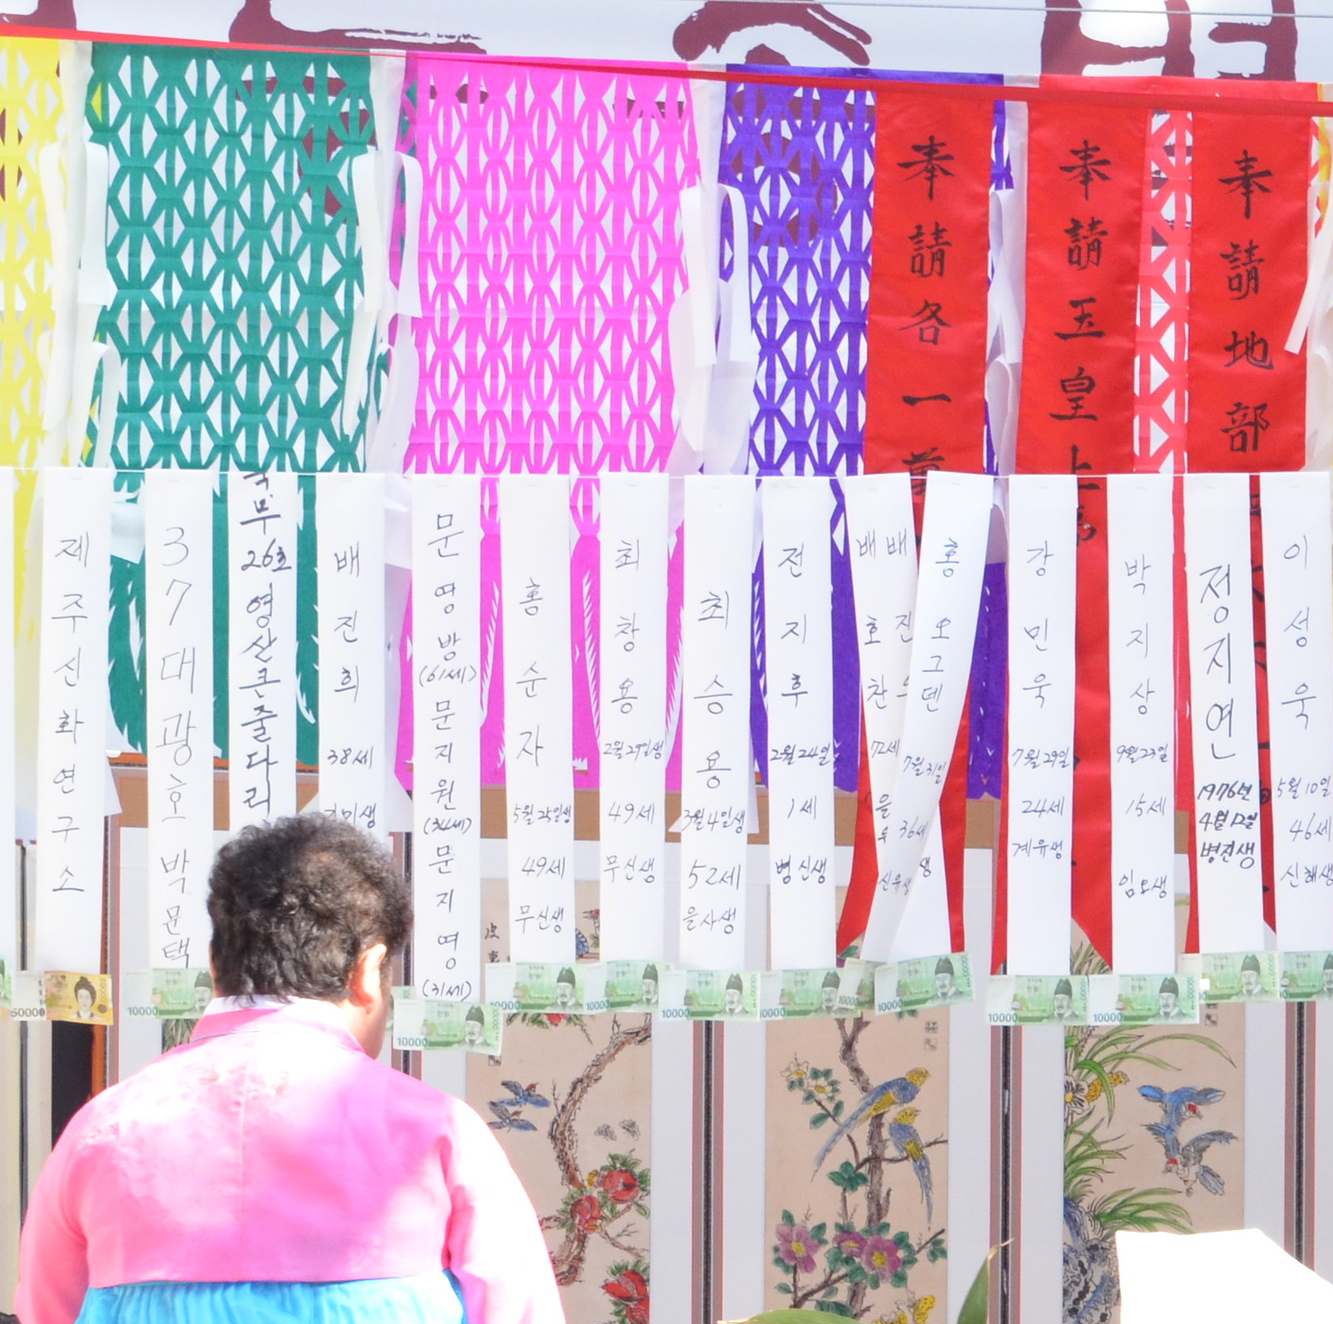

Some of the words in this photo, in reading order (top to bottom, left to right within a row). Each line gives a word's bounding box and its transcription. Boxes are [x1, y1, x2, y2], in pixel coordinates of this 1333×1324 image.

[334, 542, 361, 703] 배진희
[610, 540, 640, 716] 최창용
[778, 543, 808, 707] 전지후
[1022, 540, 1054, 709] 강민욱
[1124, 553, 1156, 716] 박지상
[1280, 534, 1318, 731] 이성욱
[418, 664, 478, 688] (61세)
[514, 577, 548, 768] 홍순자
[1199, 563, 1238, 761] 정지연
[693, 590, 733, 791] 최승용
[327, 746, 374, 772] 38세
[430, 700, 457, 814] 문지원
[1125, 792, 1166, 817] 15세
[1197, 779, 1254, 802] 1976년
[607, 802, 656, 826] 49세
[1021, 796, 1065, 818] 24세
[1289, 811, 1332, 843] 46세
[520, 856, 566, 880] 49세
[602, 855, 656, 885] 무신생
[775, 854, 828, 885] 병신생
[1200, 840, 1258, 870] 병진생
[687, 859, 743, 891] 52세
[1118, 868, 1169, 899] 임오생
[514, 905, 565, 934] 무신생
[681, 906, 738, 935] 을사생
[127, 1006, 158, 1017] 10000
[661, 1007, 689, 1019] 10000
[877, 998, 904, 1012] 10000
[988, 1012, 1018, 1023] 10000
[1093, 1012, 1124, 1023] 10000
[397, 1036, 428, 1048] 10000
